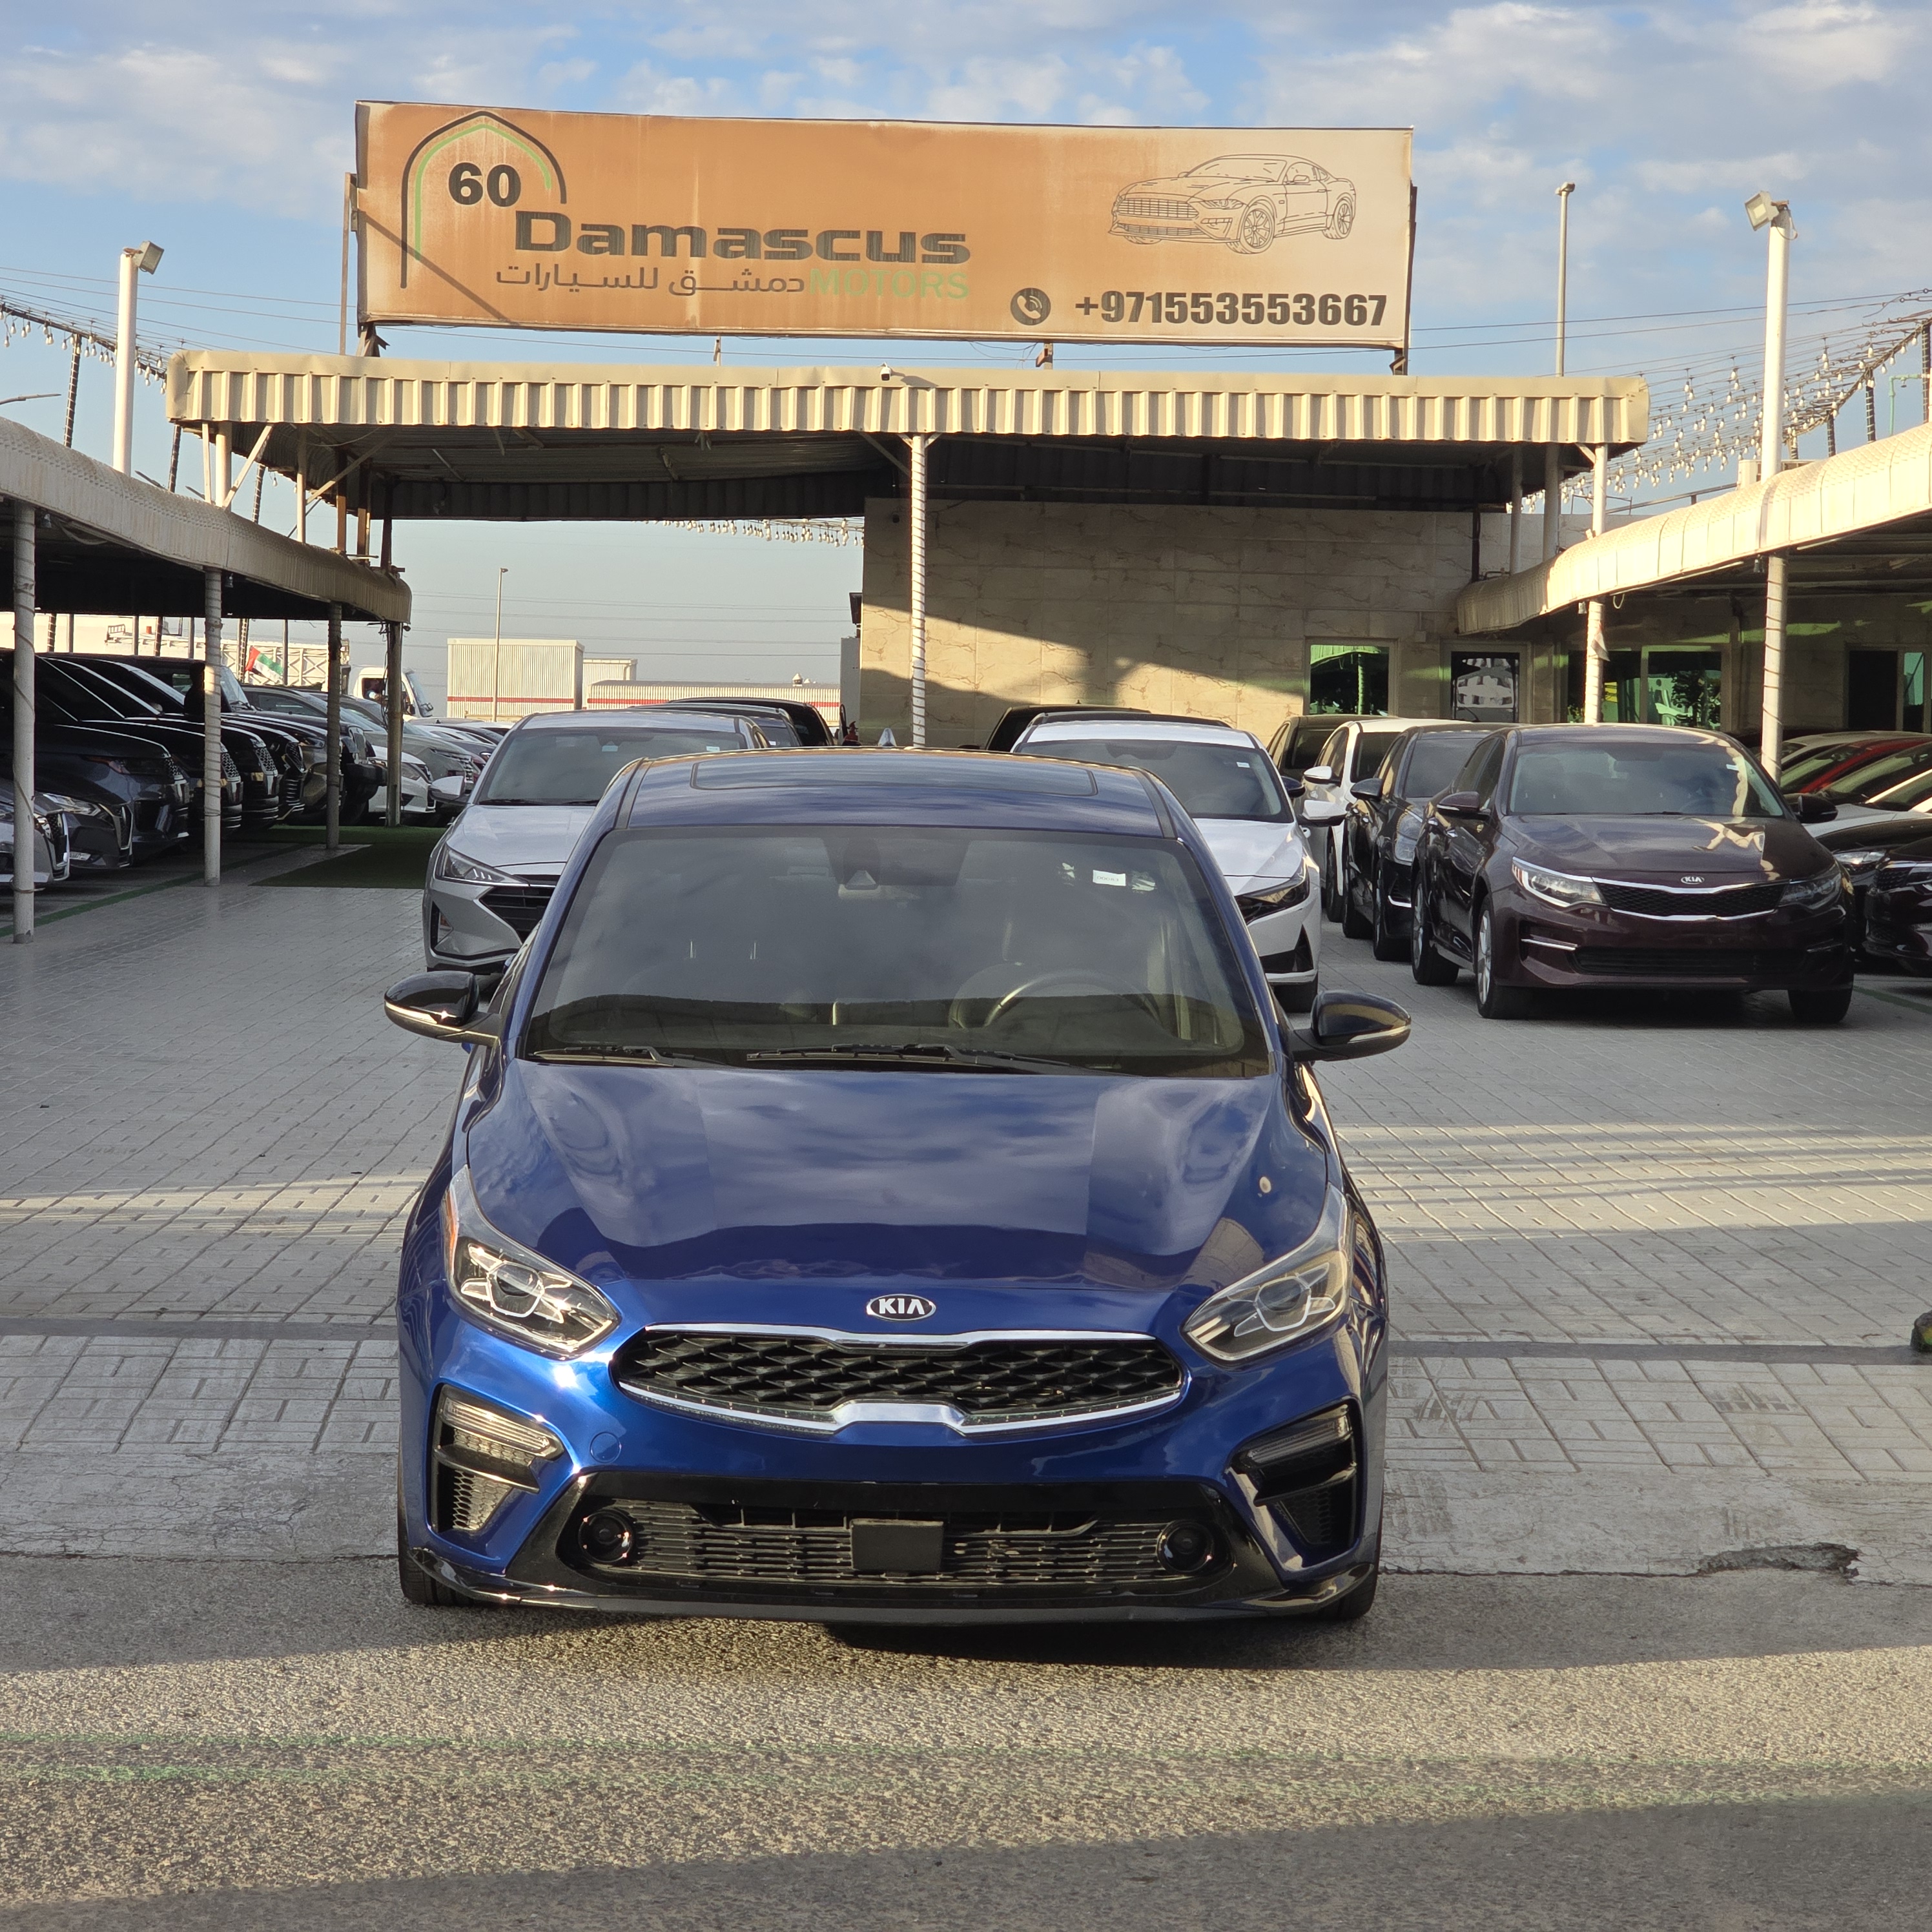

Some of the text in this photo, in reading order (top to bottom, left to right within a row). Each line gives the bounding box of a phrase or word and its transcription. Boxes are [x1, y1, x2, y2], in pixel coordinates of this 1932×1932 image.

[449, 162, 521, 207] 60
[515, 211, 971, 264] Damascus
[496, 263, 805, 296] دمشق للسيارات
[809, 268, 971, 300] MOTORS
[1075, 291, 1387, 326] +971553553667
[878, 1298, 925, 1315] KIA
